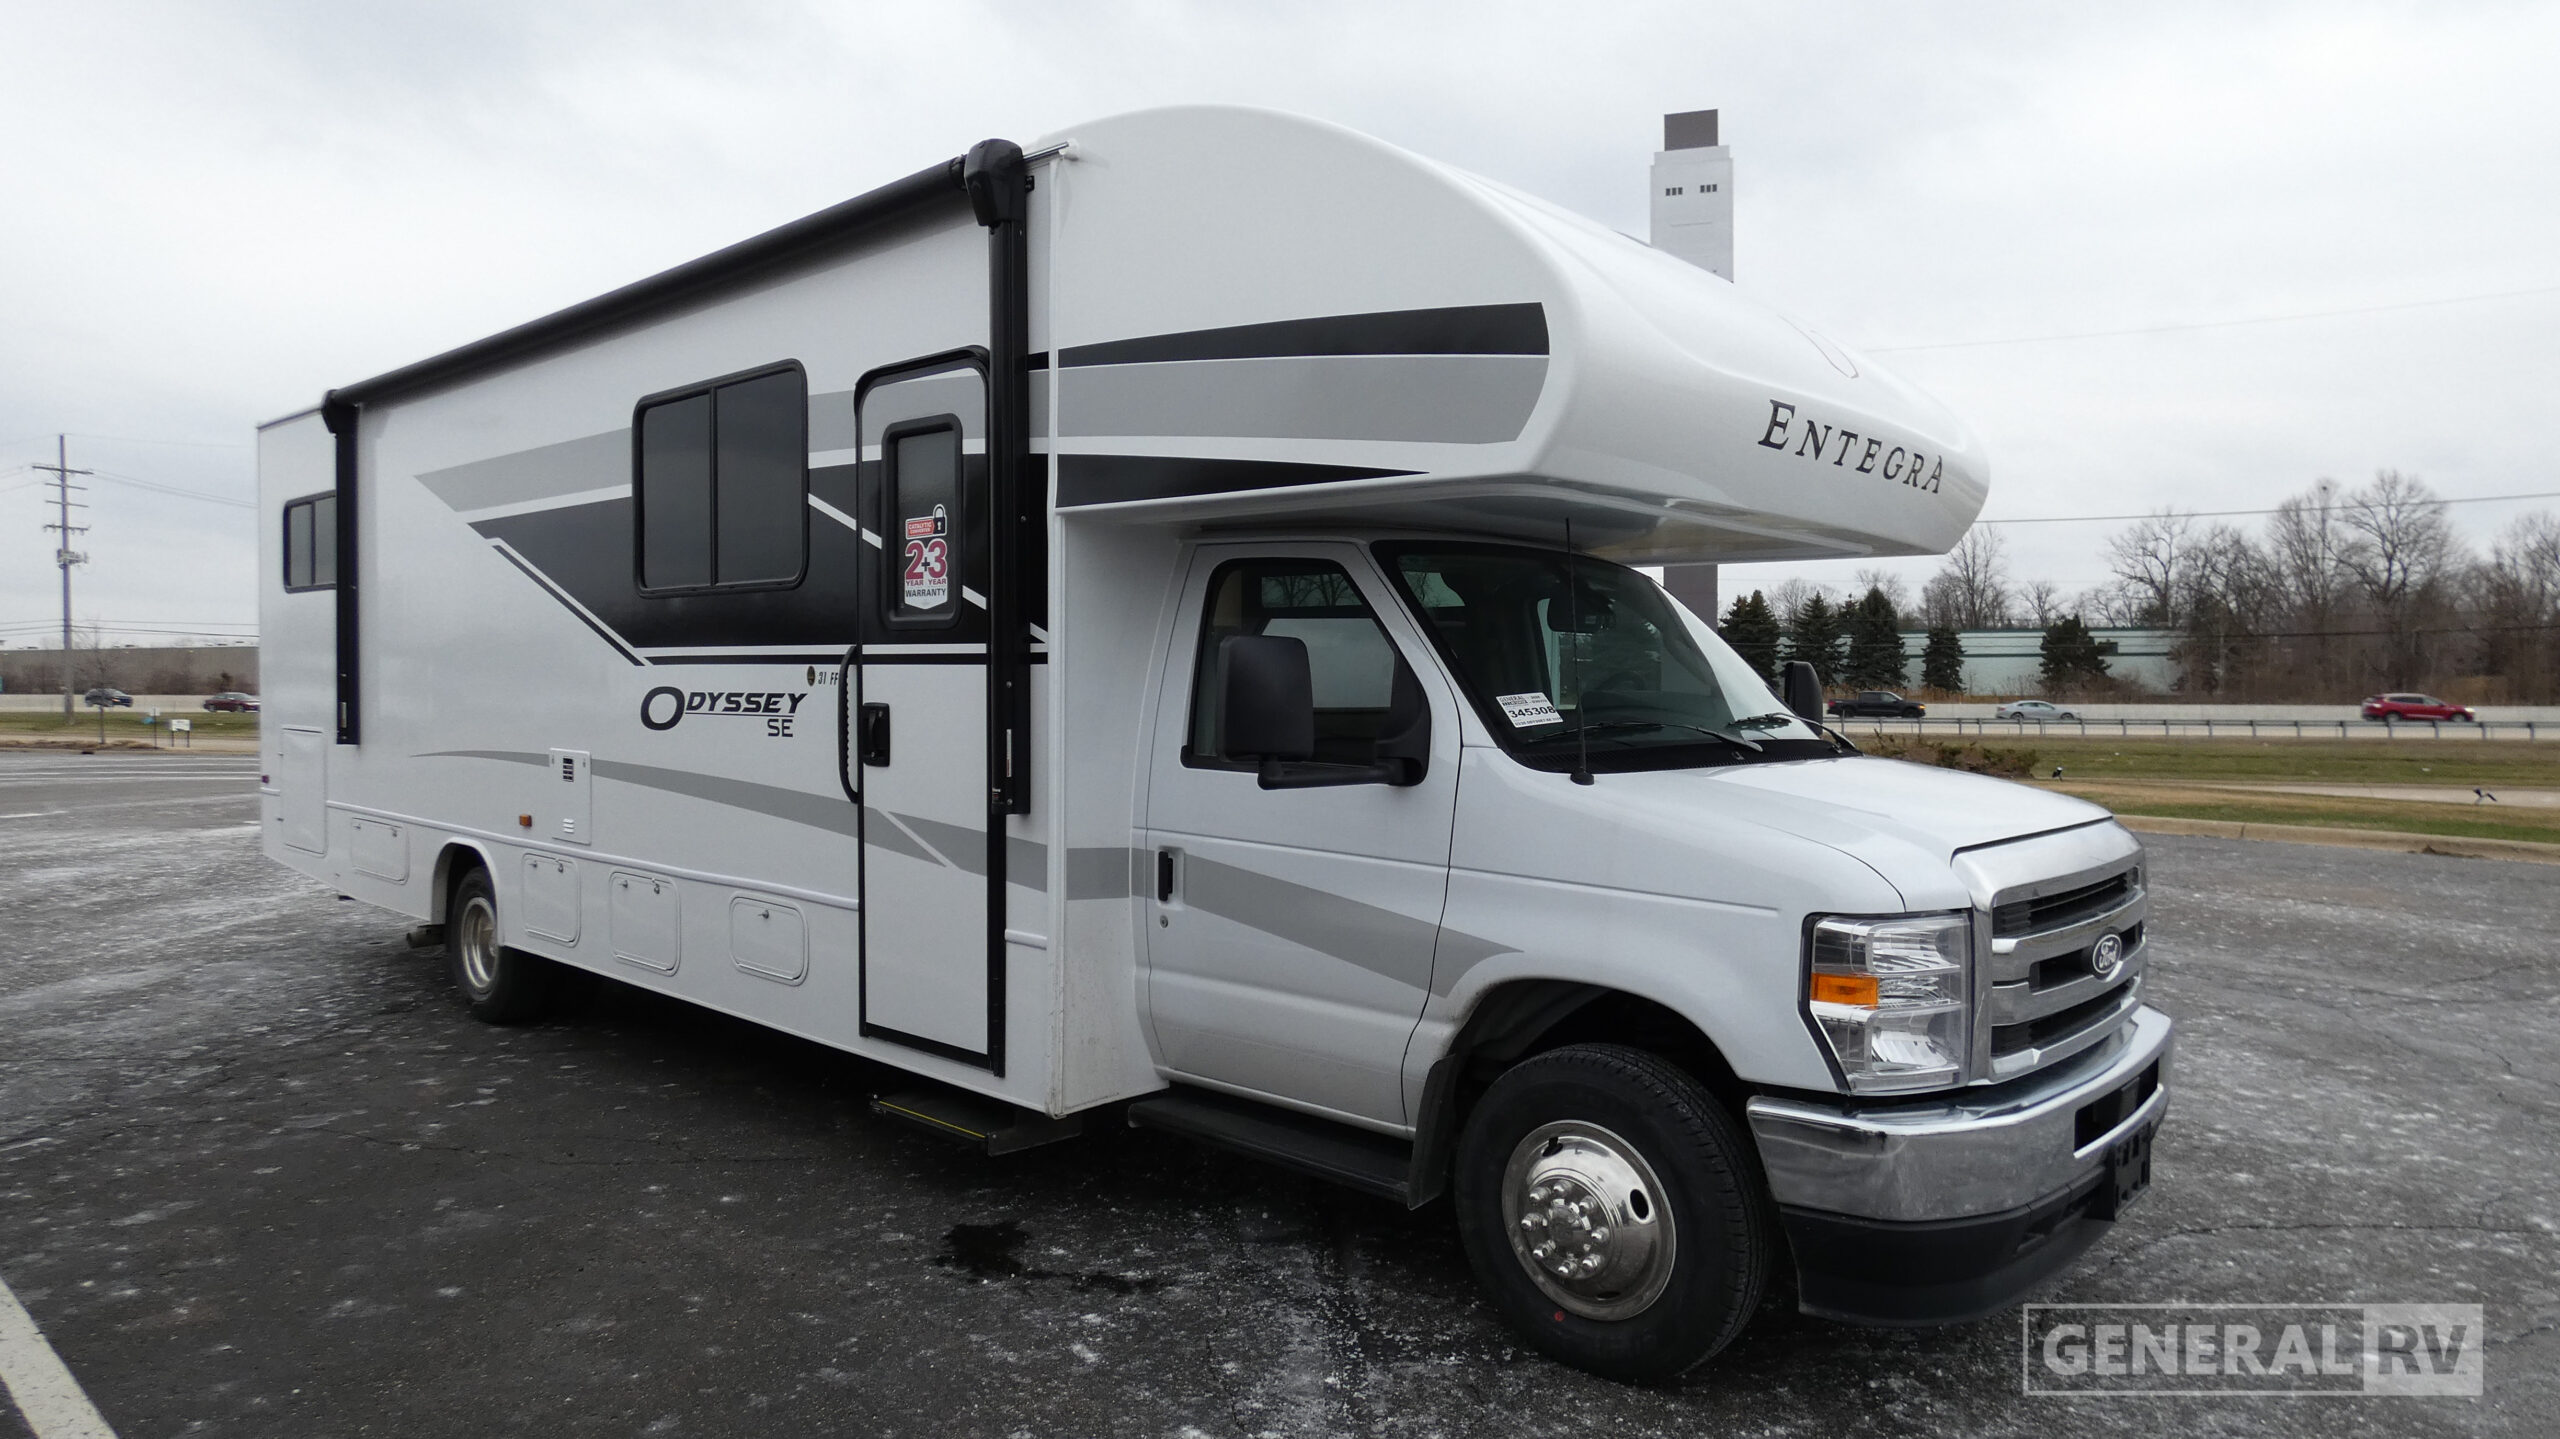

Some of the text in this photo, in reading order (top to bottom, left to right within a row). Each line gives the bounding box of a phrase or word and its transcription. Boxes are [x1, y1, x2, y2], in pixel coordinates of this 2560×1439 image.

[1757, 399, 1943, 494] ENTEGRA
[905, 588, 946, 597] WARRANTY
[818, 671, 827, 685] 31
[640, 686, 808, 731] ODYSSEY
[1509, 706, 1556, 718] 345308
[767, 719, 794, 738] SE
[2098, 940, 2118, 969] Ford
